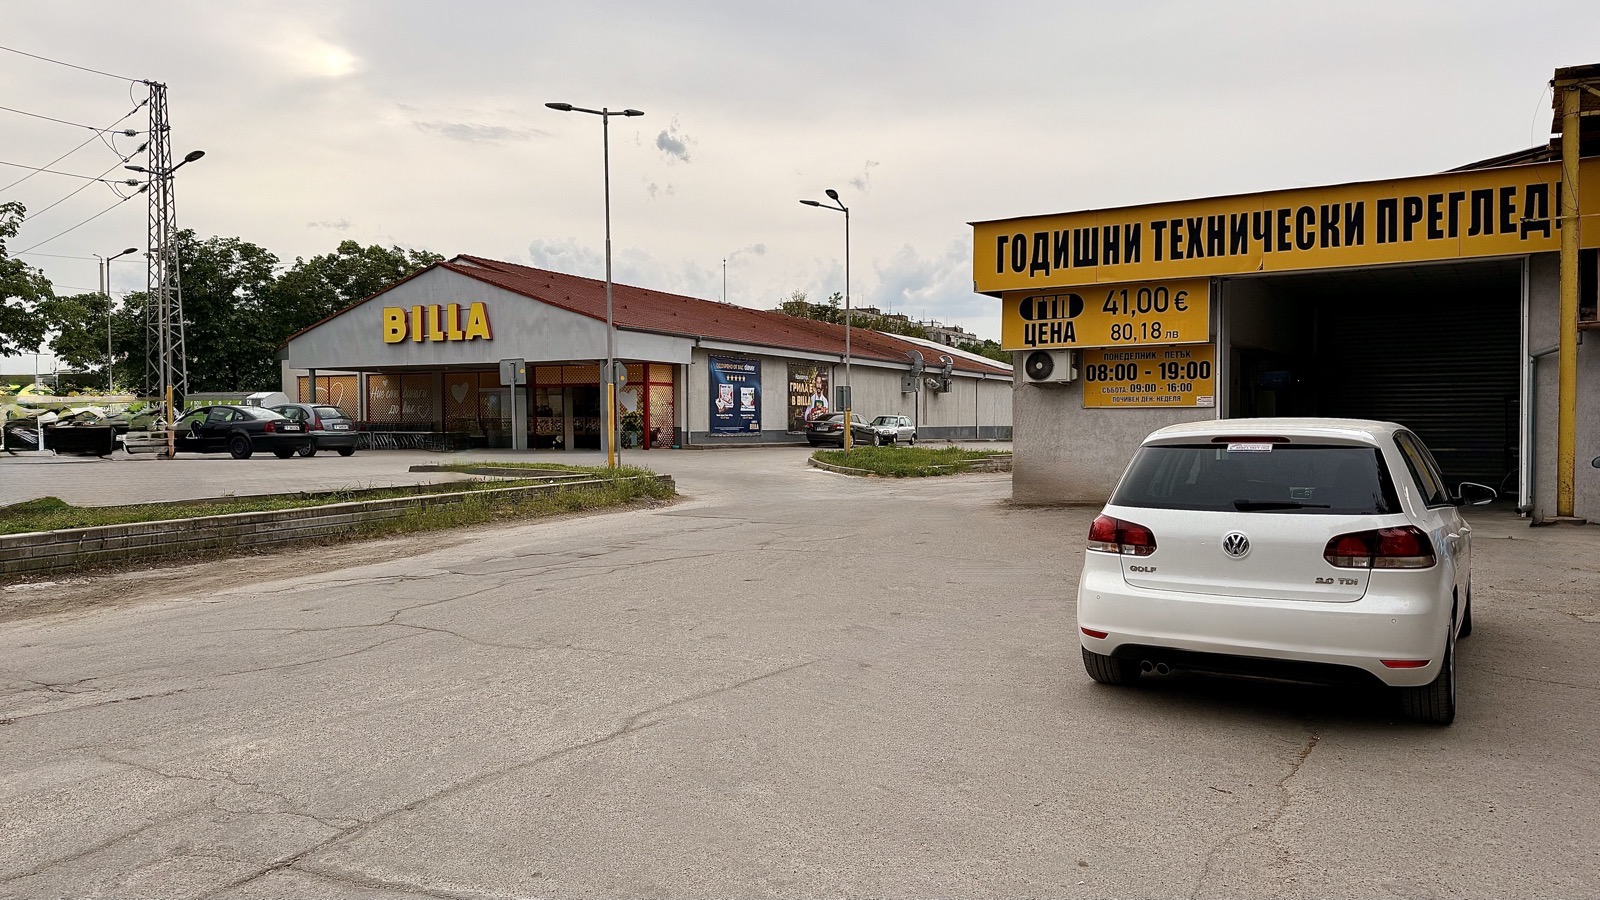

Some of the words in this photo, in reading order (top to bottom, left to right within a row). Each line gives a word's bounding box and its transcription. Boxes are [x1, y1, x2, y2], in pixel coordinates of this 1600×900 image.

[996, 222, 1142, 278] ГОДИШНИ
[1150, 201, 1364, 262] ТЕХНИЧЕСКИ
[1032, 294, 1071, 320] ГТП
[1102, 286, 1169, 317] 41,00
[1174, 290, 1189, 312] €
[383, 301, 493, 344] BILLA
[1110, 321, 1162, 343] 80,18
[1165, 330, 1179, 339] лв
[1024, 321, 1076, 347] ЦЕНА
[1103, 351, 1157, 360] ПОНЕДЕЛНИК
[1164, 350, 1191, 359] ПЕТЪК
[1085, 362, 1138, 382] 08:00
[1158, 360, 1211, 380] 19:00
[1130, 383, 1156, 393] 09:00
[1167, 382, 1192, 392] 16:00
[1130, 565, 1157, 573] GOLF
[1315, 577, 1334, 585] 2.0
